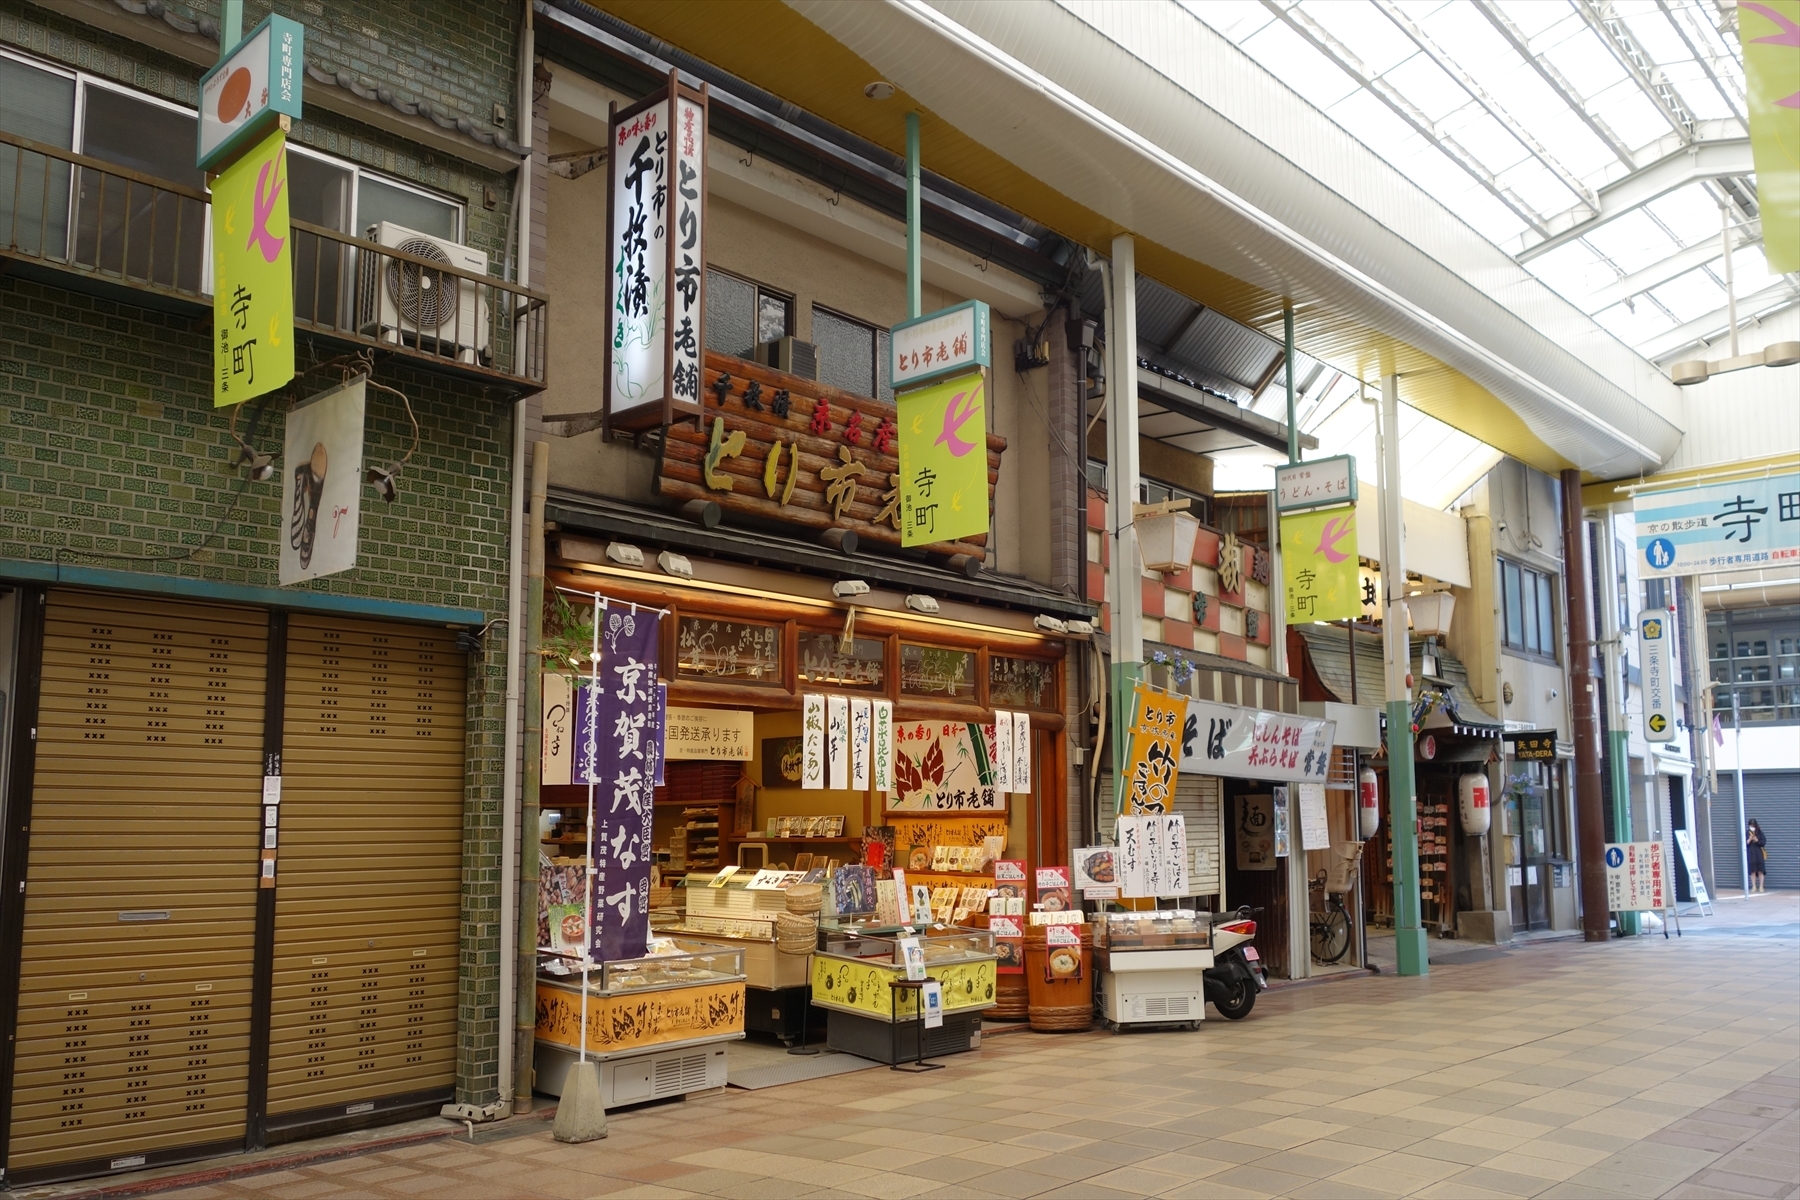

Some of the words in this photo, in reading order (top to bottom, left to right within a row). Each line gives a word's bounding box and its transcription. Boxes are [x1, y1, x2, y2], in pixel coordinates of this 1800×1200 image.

[281, 32, 293, 102] 寺町専門店会
[651, 130, 668, 239] とり市の
[622, 135, 654, 319] 千枚漬
[464, 256, 483, 266] Panasonic
[673, 159, 700, 401] とり市老舗
[230, 283, 257, 385] 寺町
[899, 330, 968, 371] とり市老舗
[713, 371, 793, 420] 千枚漬
[914, 466, 939, 535] 寺町
[1280, 477, 1348, 500] うどん・そば
[1648, 517, 1708, 534] 京の散歩道
[1709, 552, 1769, 567] 歩行者専用道路
[1772, 549, 1800, 560] 自転車
[1296, 568, 1318, 617] 寺町
[803, 648, 880, 687] とり市老舗
[1649, 644, 1661, 710] 三条寺町交番
[665, 725, 742, 743] 国発送承ります
[897, 723, 932, 744] 京の香り
[943, 723, 966, 737] 日本一
[1145, 705, 1177, 727] とり市
[1253, 723, 1302, 746] にしんそば
[806, 702, 822, 781] 山椒たくあん
[1248, 745, 1299, 768] 天ぷらそば
[1518, 738, 1552, 750] 矢田寺
[1518, 750, 1553, 759] YATA-DERA
[606, 656, 647, 927] 京賀茂なす
[936, 788, 995, 810] とり市老舗
[1125, 827, 1136, 872] 天むす
[595, 819, 609, 949] 上賀茂特産野菜研究会
[1628, 845, 1637, 907] 自転車は押して下さい
[1651, 843, 1662, 908] 歩行者専用道路
